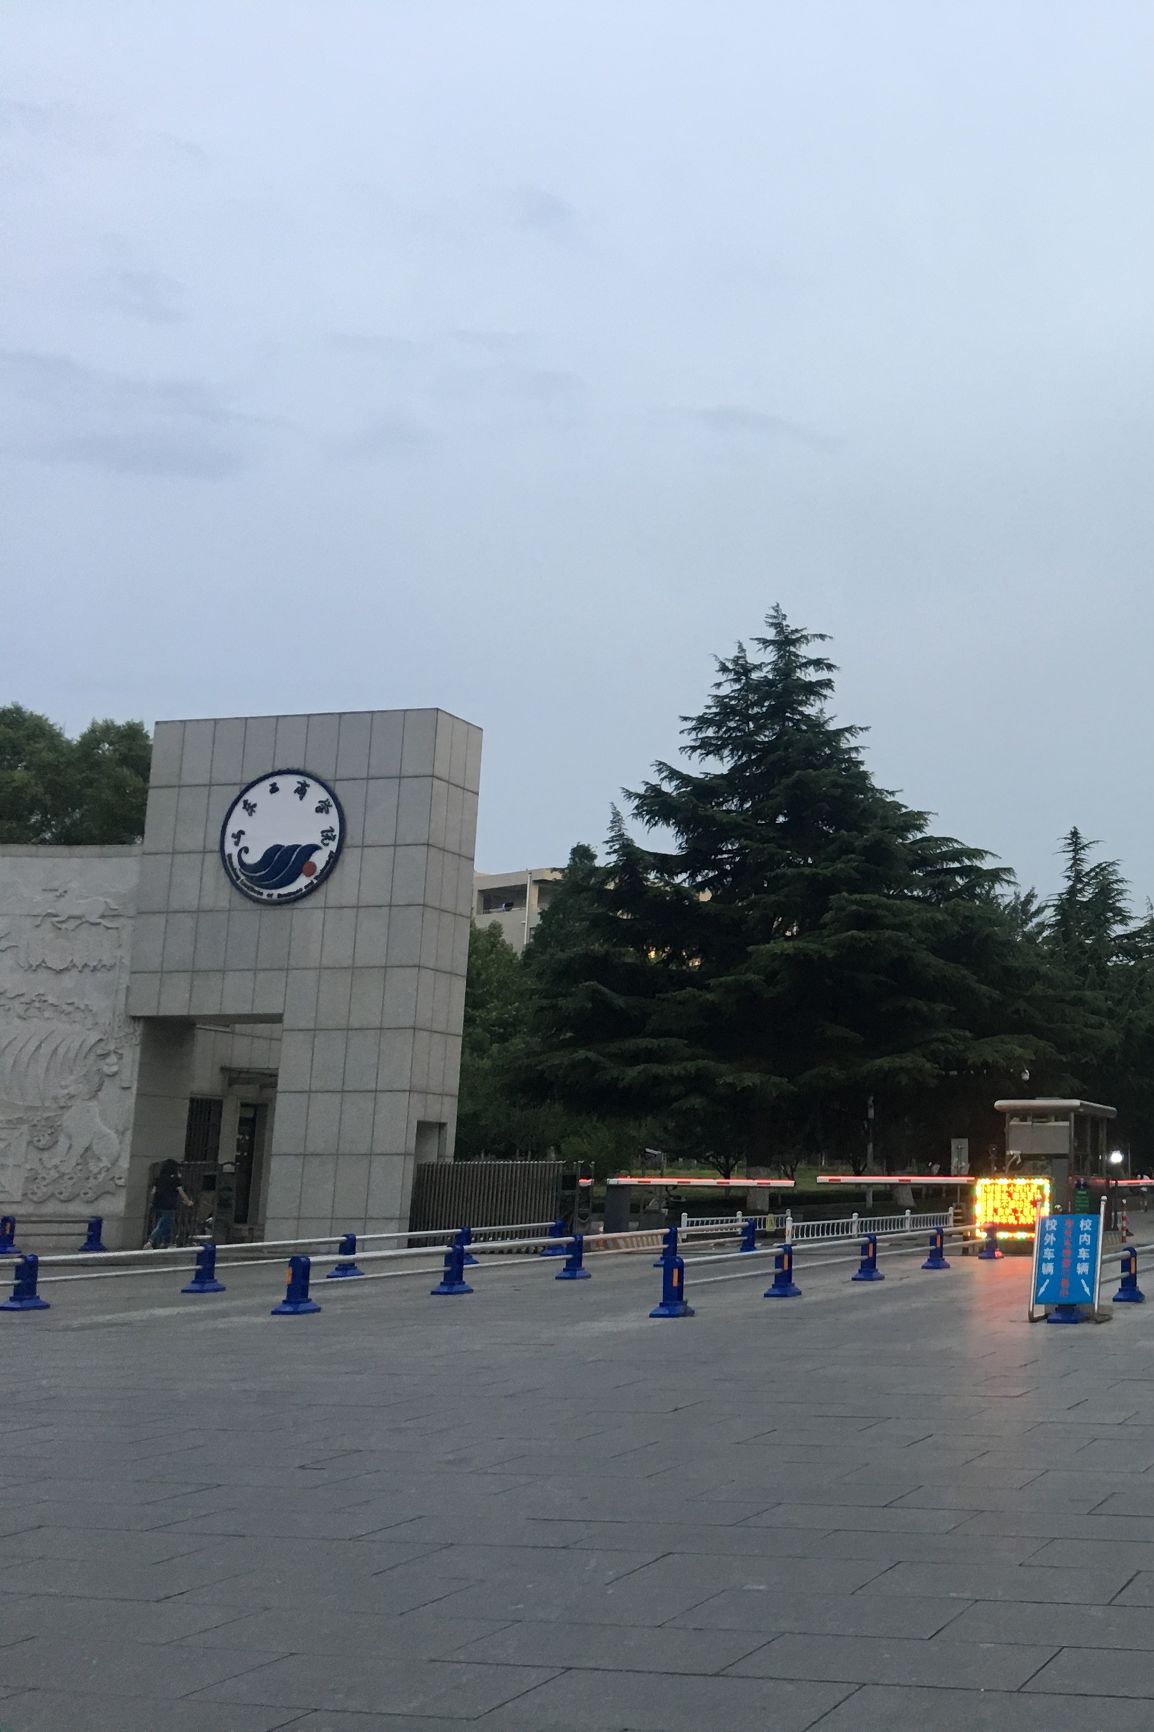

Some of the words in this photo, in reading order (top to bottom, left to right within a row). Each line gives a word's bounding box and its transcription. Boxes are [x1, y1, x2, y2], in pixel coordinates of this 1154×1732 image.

[1041, 1218, 1057, 1276] 校外车辆
[1076, 1218, 1092, 1275] 校内车辆
